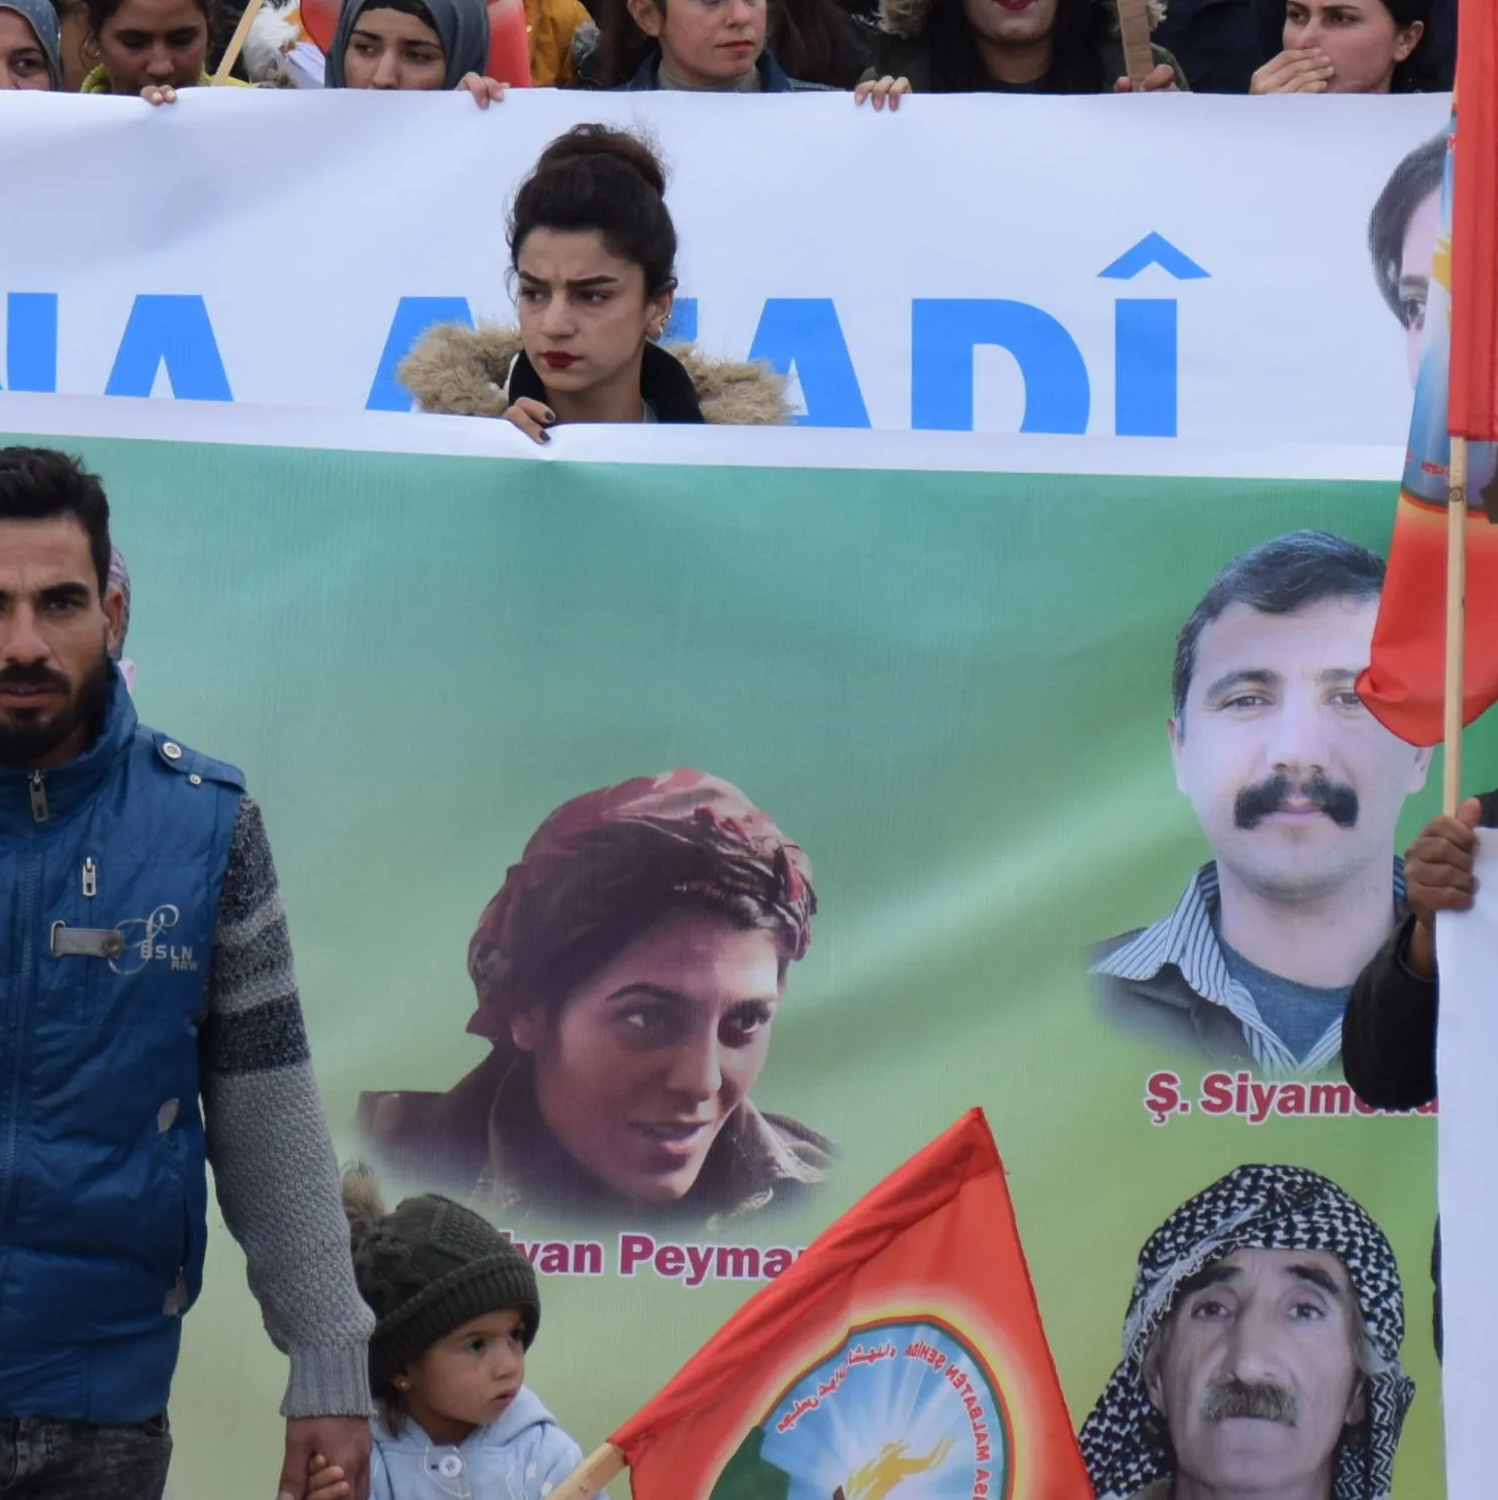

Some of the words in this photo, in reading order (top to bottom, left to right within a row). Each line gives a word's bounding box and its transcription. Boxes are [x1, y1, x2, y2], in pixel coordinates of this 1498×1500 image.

[365, 231, 1213, 438] AADÎ
[1146, 1072, 1190, 1124] Ş.
[1199, 1072, 1439, 1123] Siyam
[619, 1232, 810, 1287] Peyma
